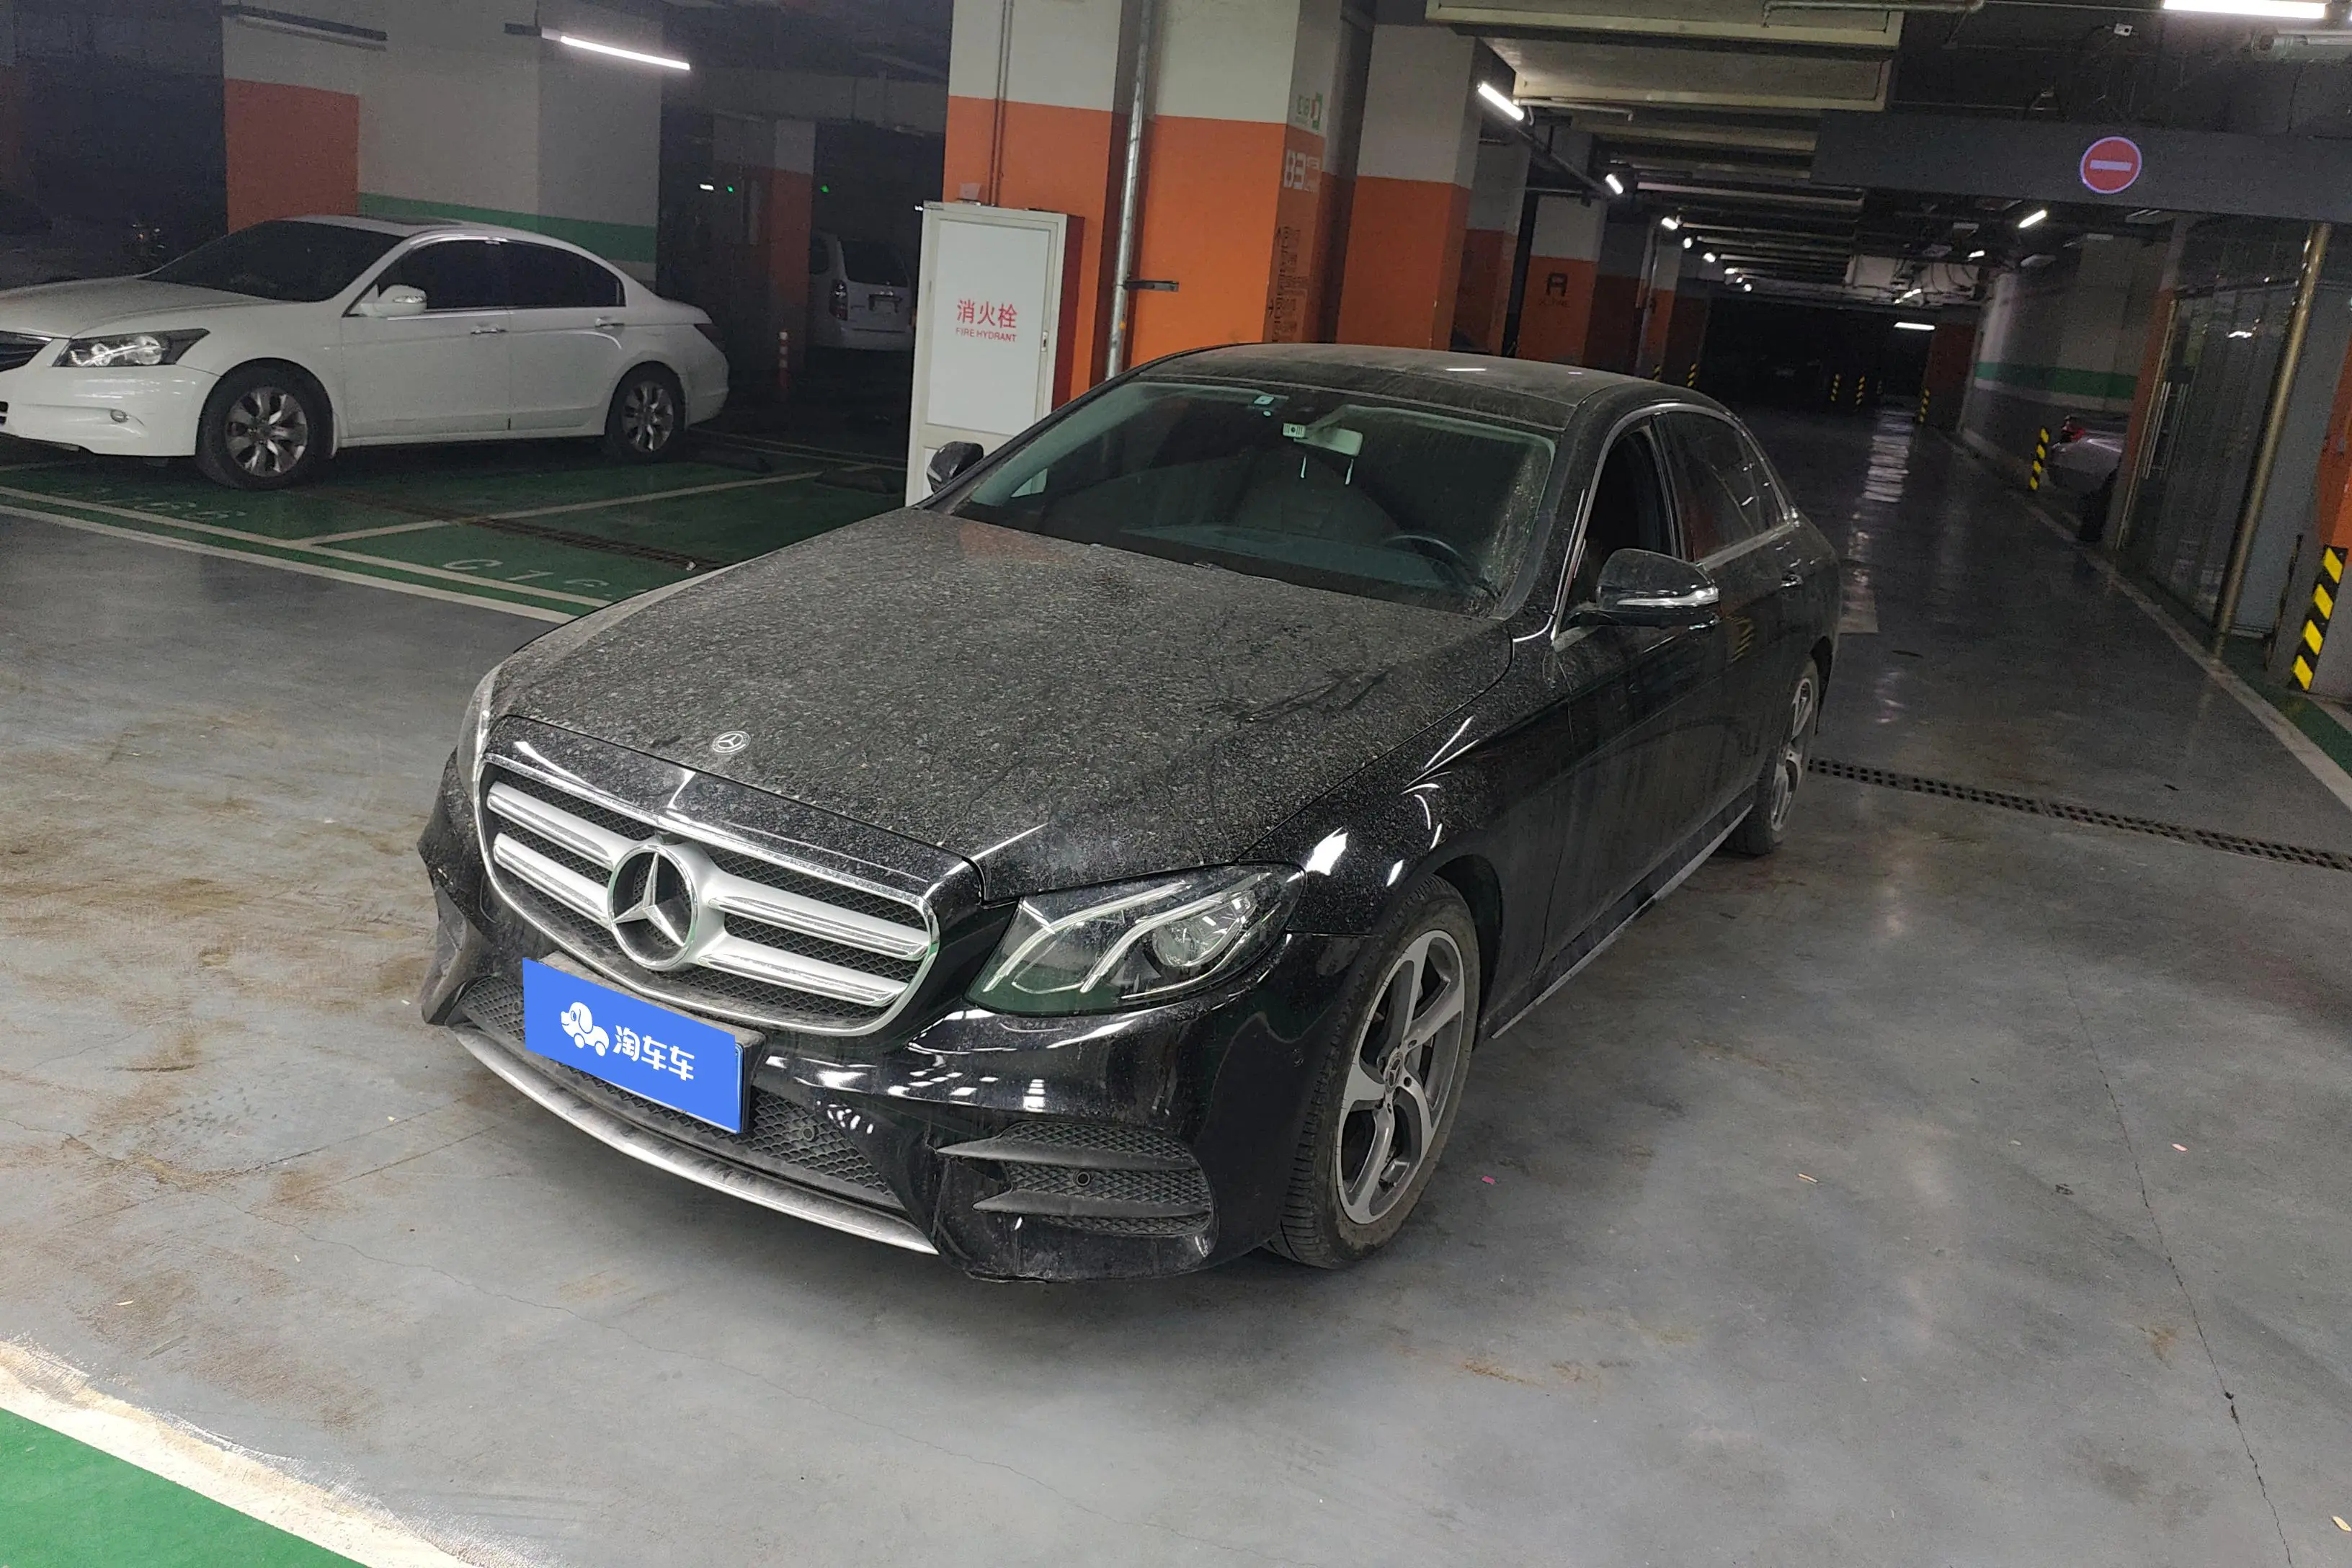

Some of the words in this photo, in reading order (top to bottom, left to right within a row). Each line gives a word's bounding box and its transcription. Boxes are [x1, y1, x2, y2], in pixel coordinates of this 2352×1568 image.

[1283, 149, 1306, 190] B3
[956, 299, 1017, 329] 消火栓
[956, 327, 975, 337] FIRE
[976, 330, 1017, 342] HYDRANT
